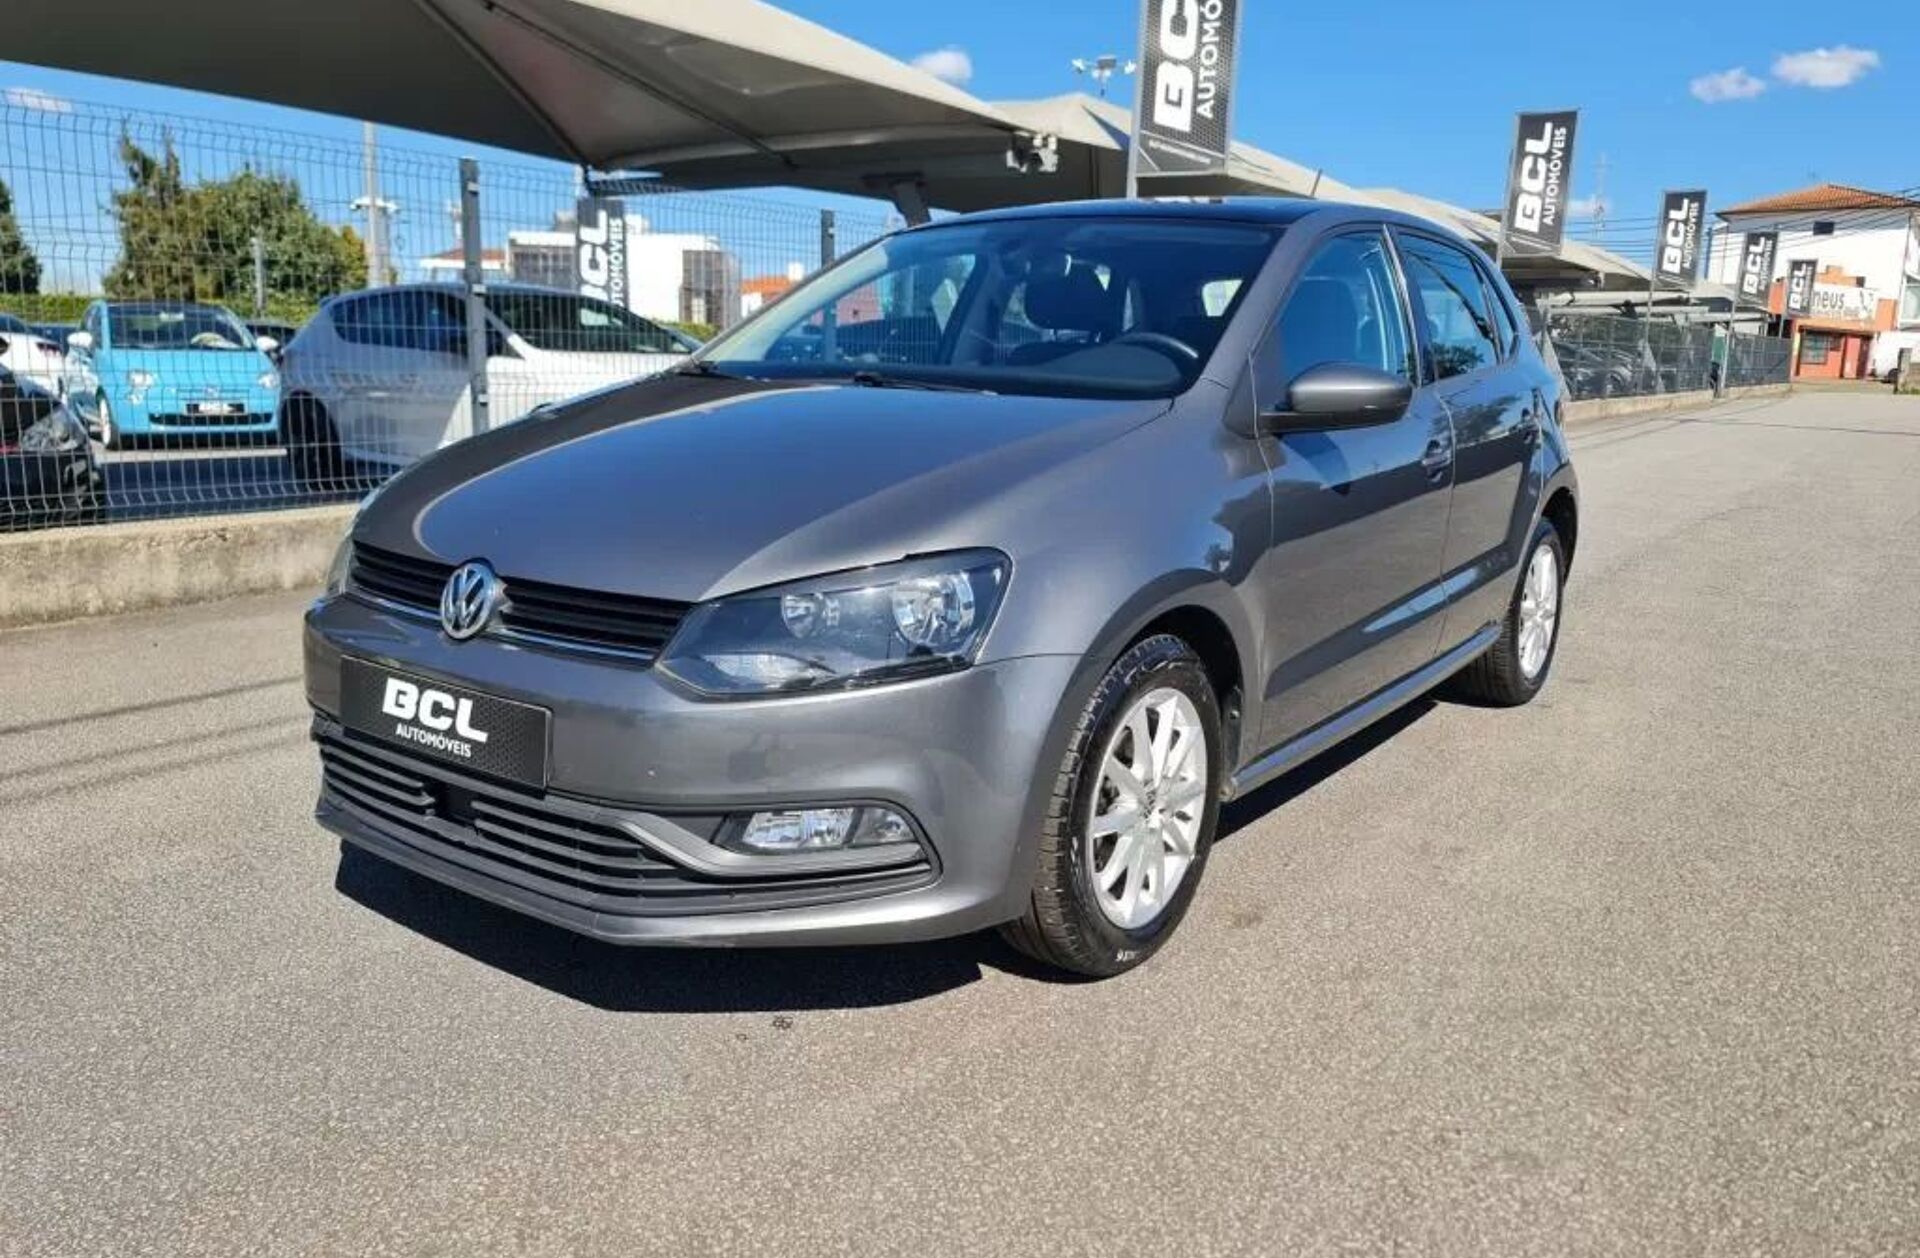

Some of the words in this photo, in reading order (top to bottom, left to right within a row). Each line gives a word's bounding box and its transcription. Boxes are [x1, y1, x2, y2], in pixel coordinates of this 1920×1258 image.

[1514, 122, 1553, 233] BCL
[608, 217, 624, 307] TOMÓVEIS
[1662, 198, 1690, 275] BCL
[1743, 236, 1766, 295] BCL
[382, 676, 489, 744] BCL
[395, 722, 472, 759] AUTOMÓVEIS
